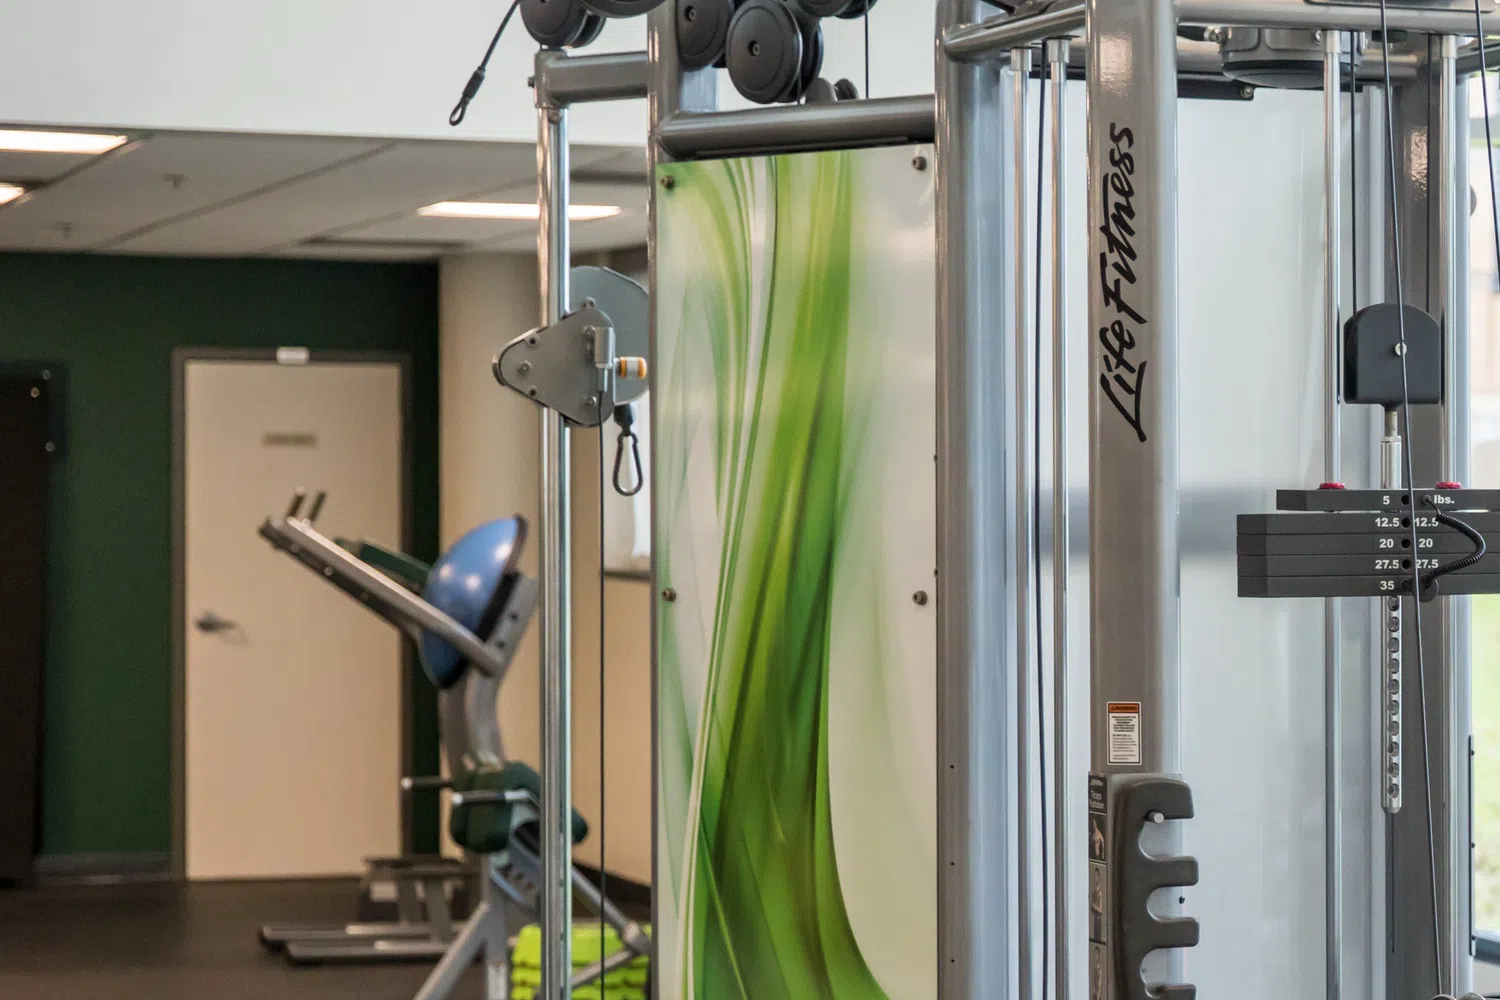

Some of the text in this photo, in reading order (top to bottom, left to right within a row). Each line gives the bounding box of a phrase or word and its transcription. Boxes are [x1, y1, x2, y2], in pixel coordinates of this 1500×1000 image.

[1099, 122, 1148, 443] Life Fitness
[1383, 494, 1455, 505] 5 lbs.
[1375, 518, 1439, 527] 12.5 12.5
[1379, 538, 1434, 549] 20 20
[1375, 560, 1439, 569] 27.5 27.5
[1380, 581, 1395, 590] 35
